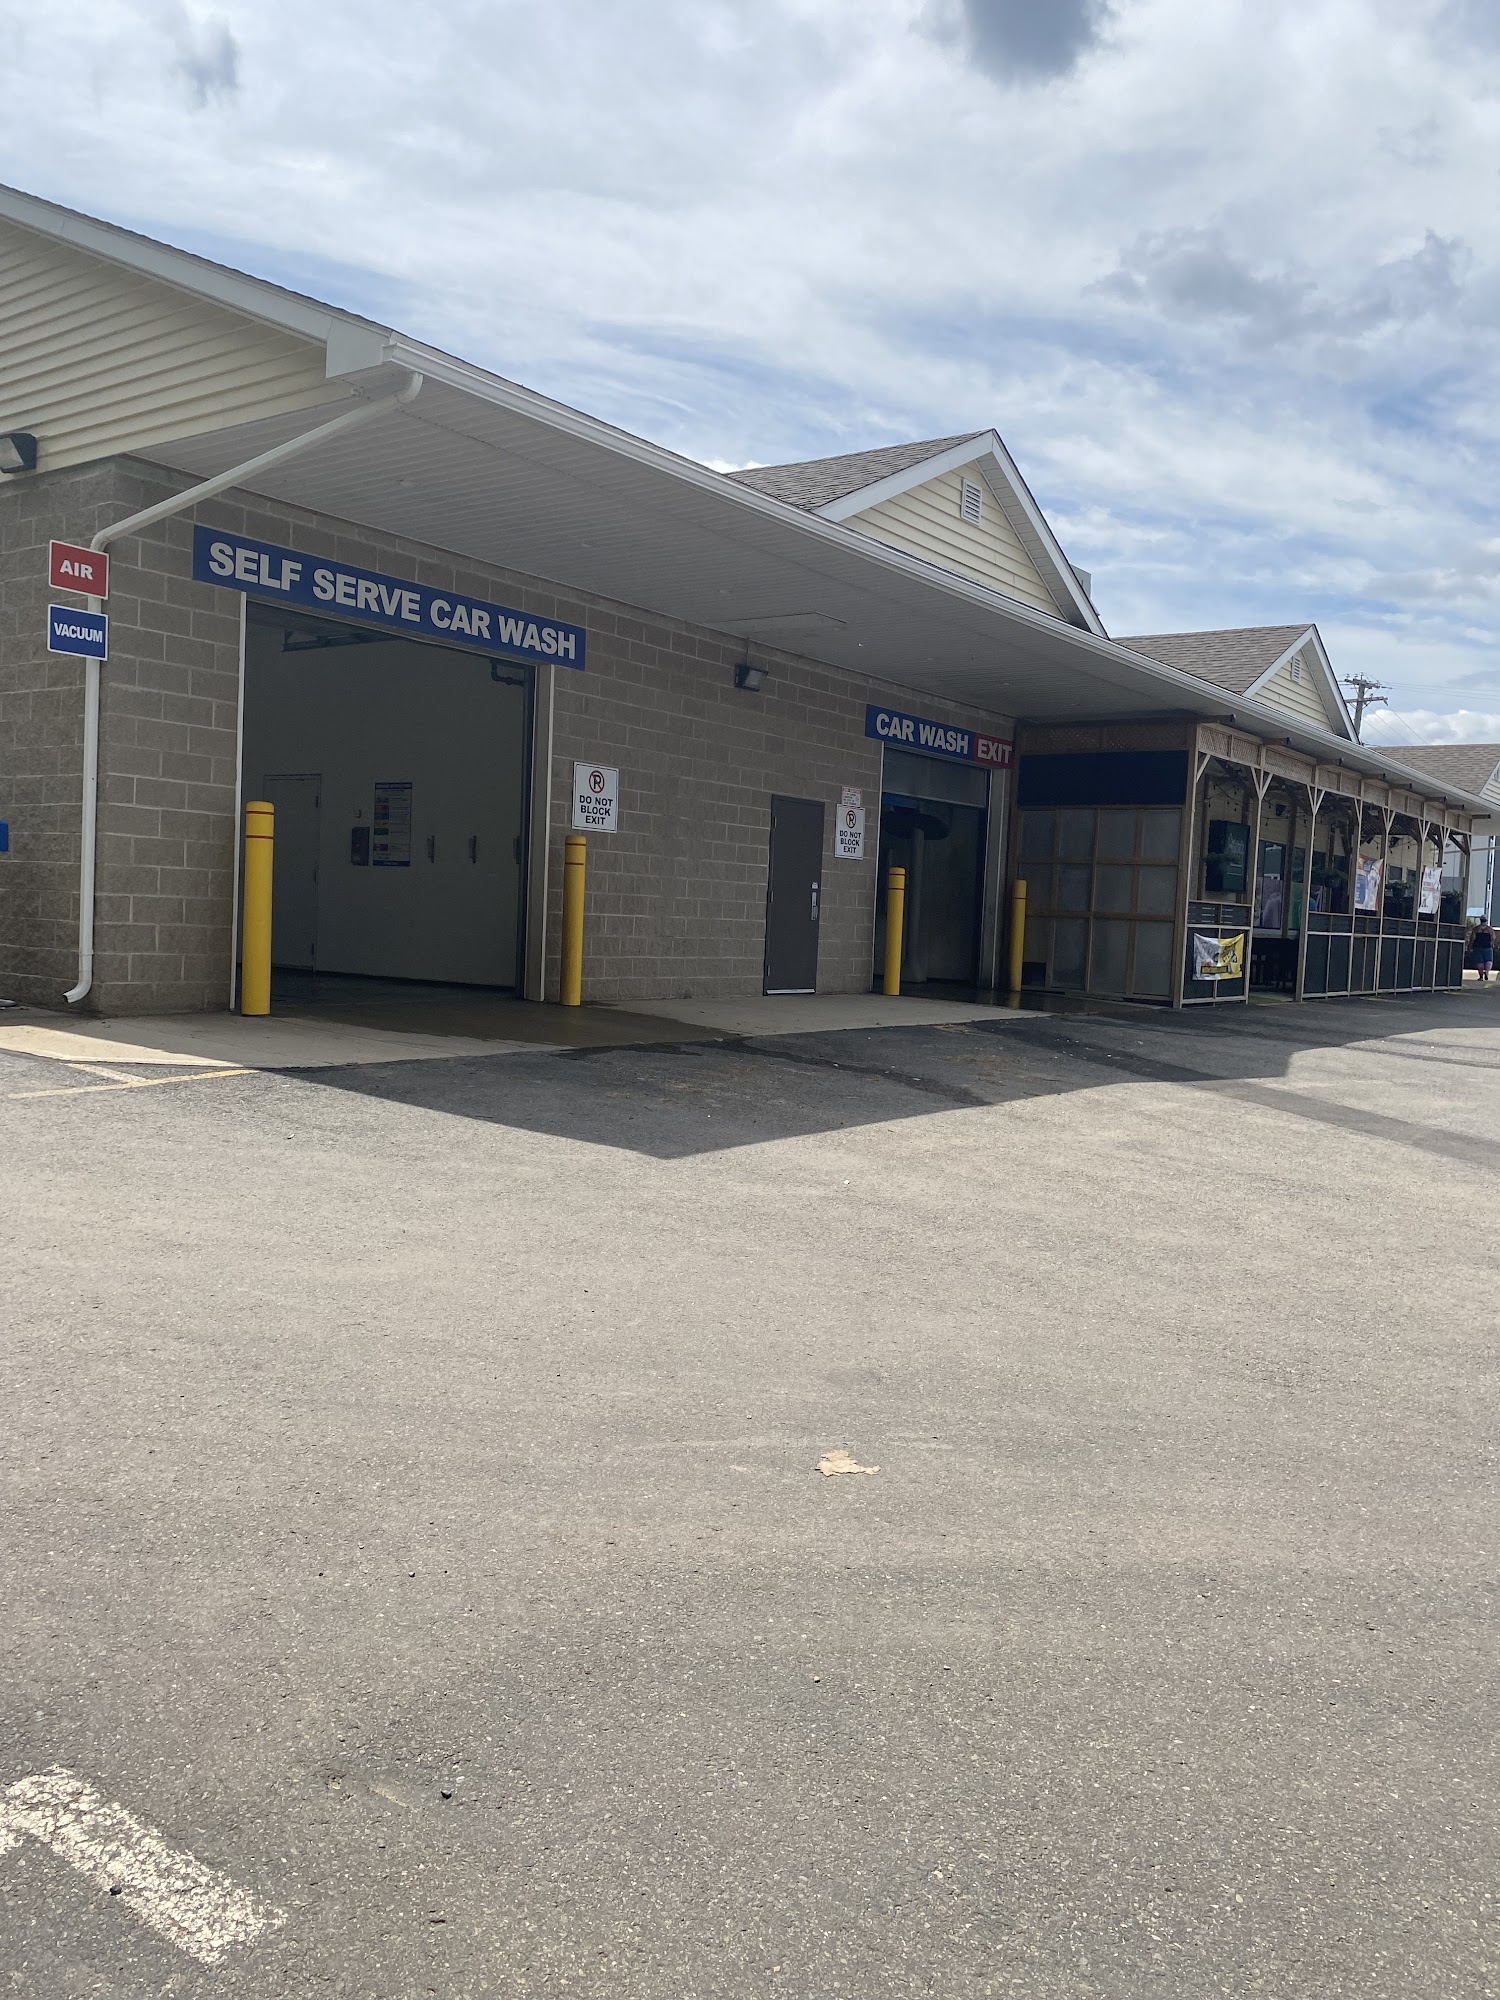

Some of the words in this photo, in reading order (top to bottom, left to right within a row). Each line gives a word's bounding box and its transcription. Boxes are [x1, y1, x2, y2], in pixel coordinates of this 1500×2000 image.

[60, 560, 93, 580] AIR
[208, 542, 302, 591] SELF
[312, 568, 421, 622] SERVE
[430, 599, 491, 640] CAR
[498, 614, 576, 660] WASH
[53, 622, 103, 643] VACUUM
[876, 713, 914, 742] CAR
[919, 723, 969, 755] WASH
[977, 738, 1013, 764] EXIT
[579, 795, 591, 804] DO
[595, 797, 613, 806] NOT
[580, 805, 611, 816] BLOCK
[585, 815, 606, 825] EXIT
[840, 837, 860, 847] BLOCK
[843, 846, 857, 854] EXIT
